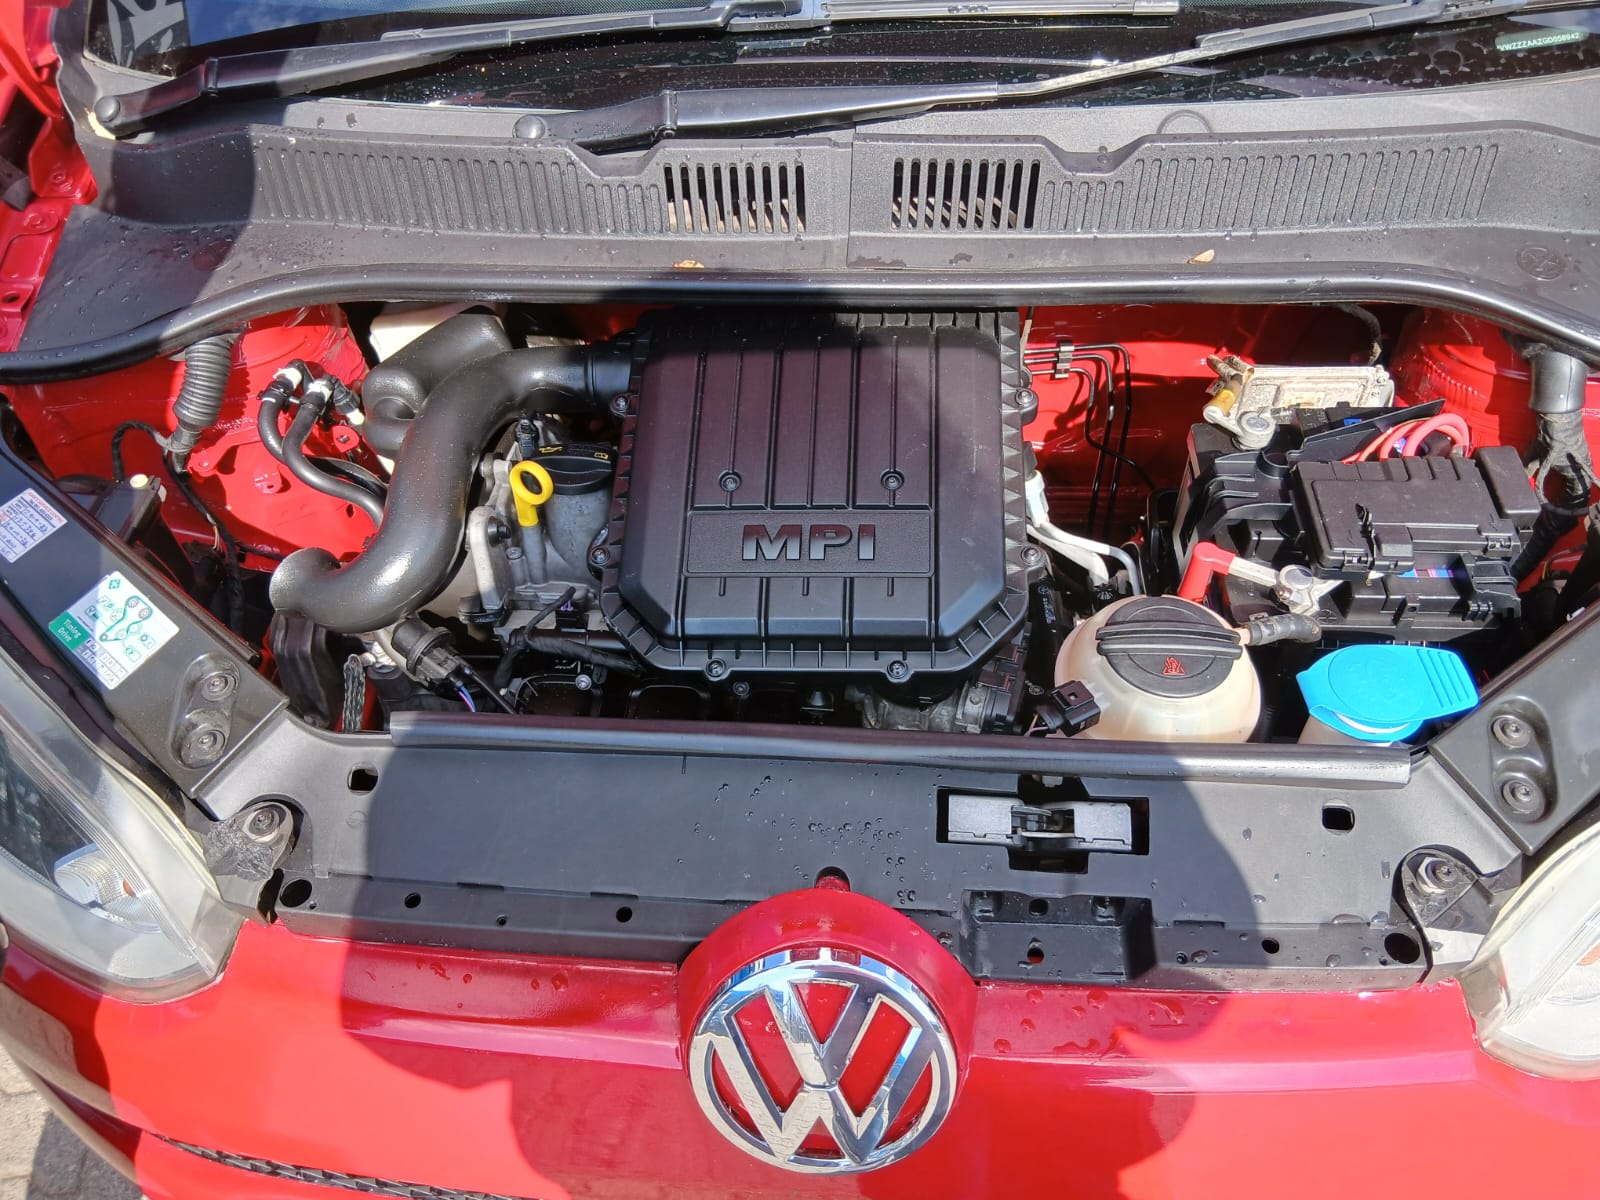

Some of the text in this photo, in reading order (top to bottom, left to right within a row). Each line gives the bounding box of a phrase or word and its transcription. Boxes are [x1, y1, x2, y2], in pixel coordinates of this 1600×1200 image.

[742, 524, 876, 560] MPI
[57, 627, 73, 642] Drive
[63, 619, 82, 638] Timing
